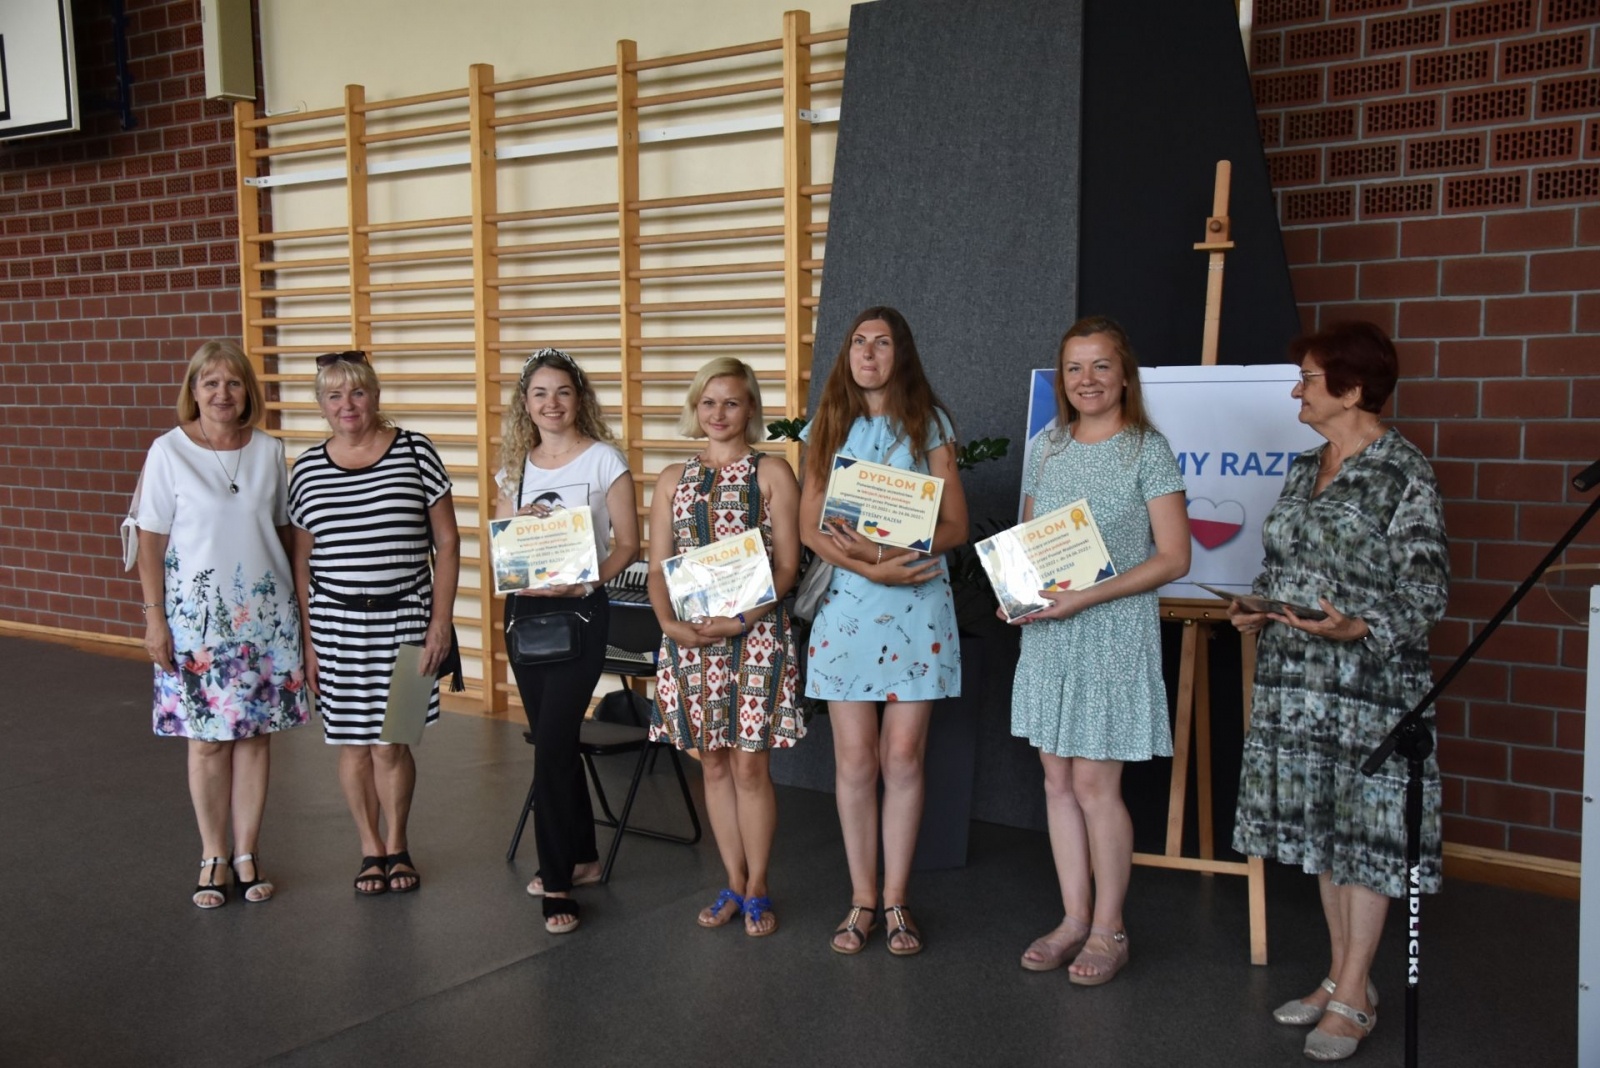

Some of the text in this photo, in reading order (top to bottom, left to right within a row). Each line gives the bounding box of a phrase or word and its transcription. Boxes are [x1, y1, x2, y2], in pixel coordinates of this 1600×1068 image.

[859, 471, 915, 490] DYPLOM
[516, 520, 567, 534] DYPLOM
[1025, 520, 1067, 542] PLOM
[698, 547, 739, 565] YPLOM
[1409, 865, 1419, 984] WIDLICKI
